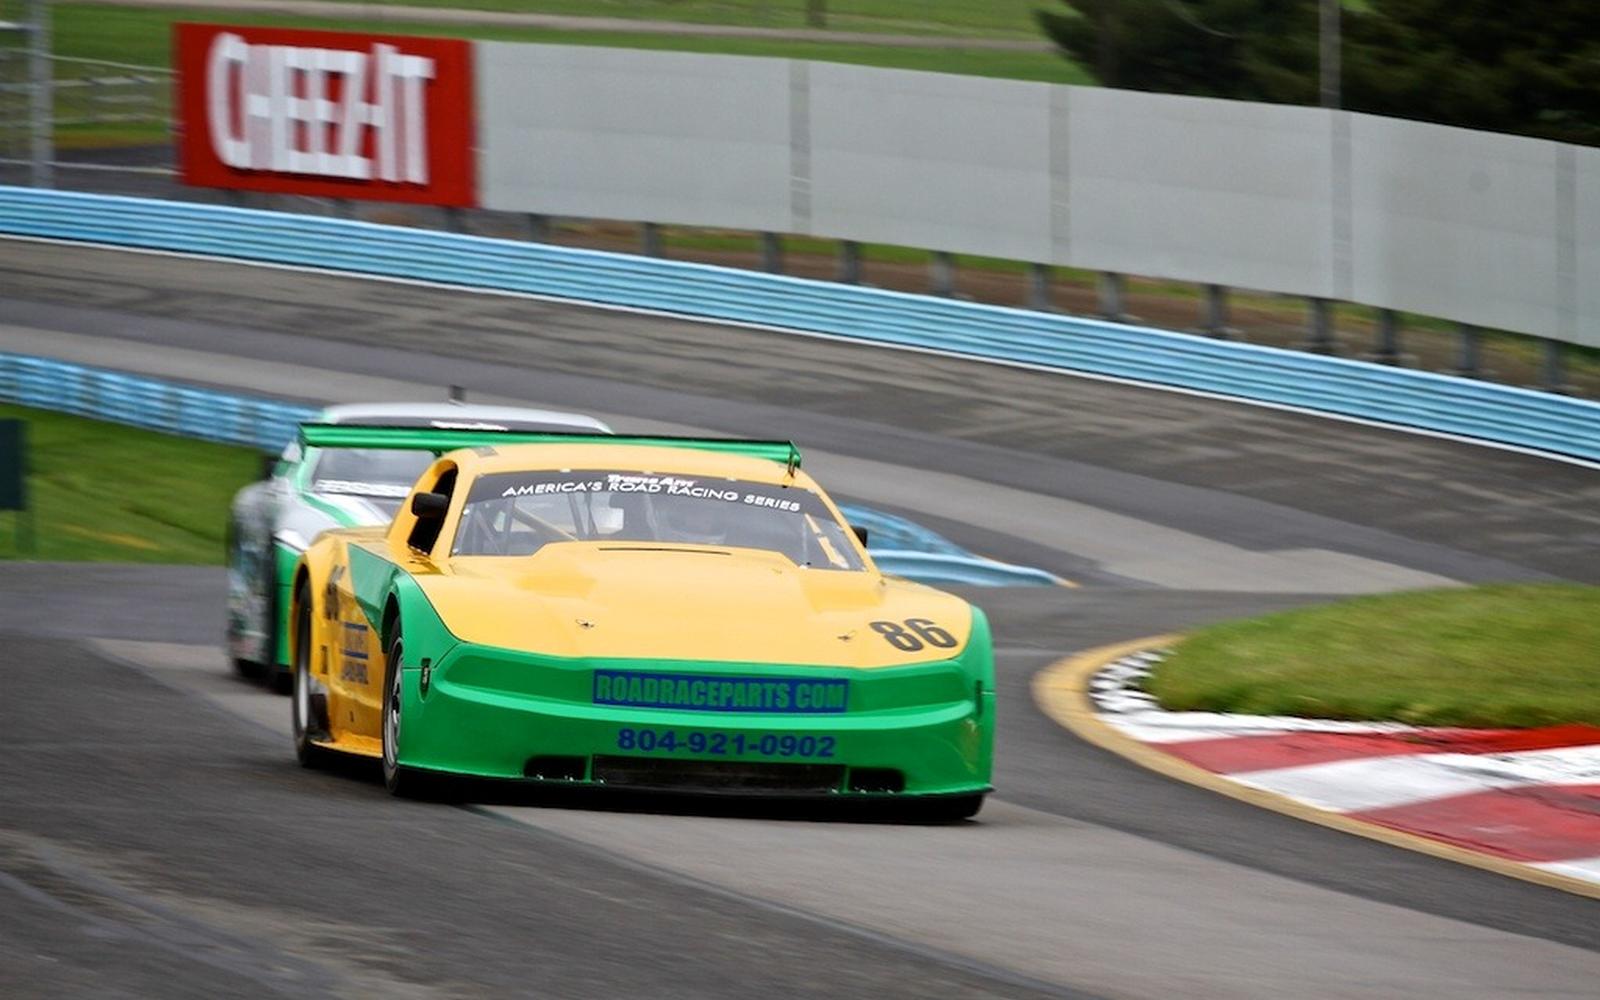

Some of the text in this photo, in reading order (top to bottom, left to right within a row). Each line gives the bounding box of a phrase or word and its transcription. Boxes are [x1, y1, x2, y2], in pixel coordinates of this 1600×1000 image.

[502, 482, 800, 512] AMERICA'S ROAD RACING SERIES
[869, 618, 958, 652] 86
[596, 675, 790, 708] ROADRACEPARTS
[617, 728, 836, 758] 804-921-0902
